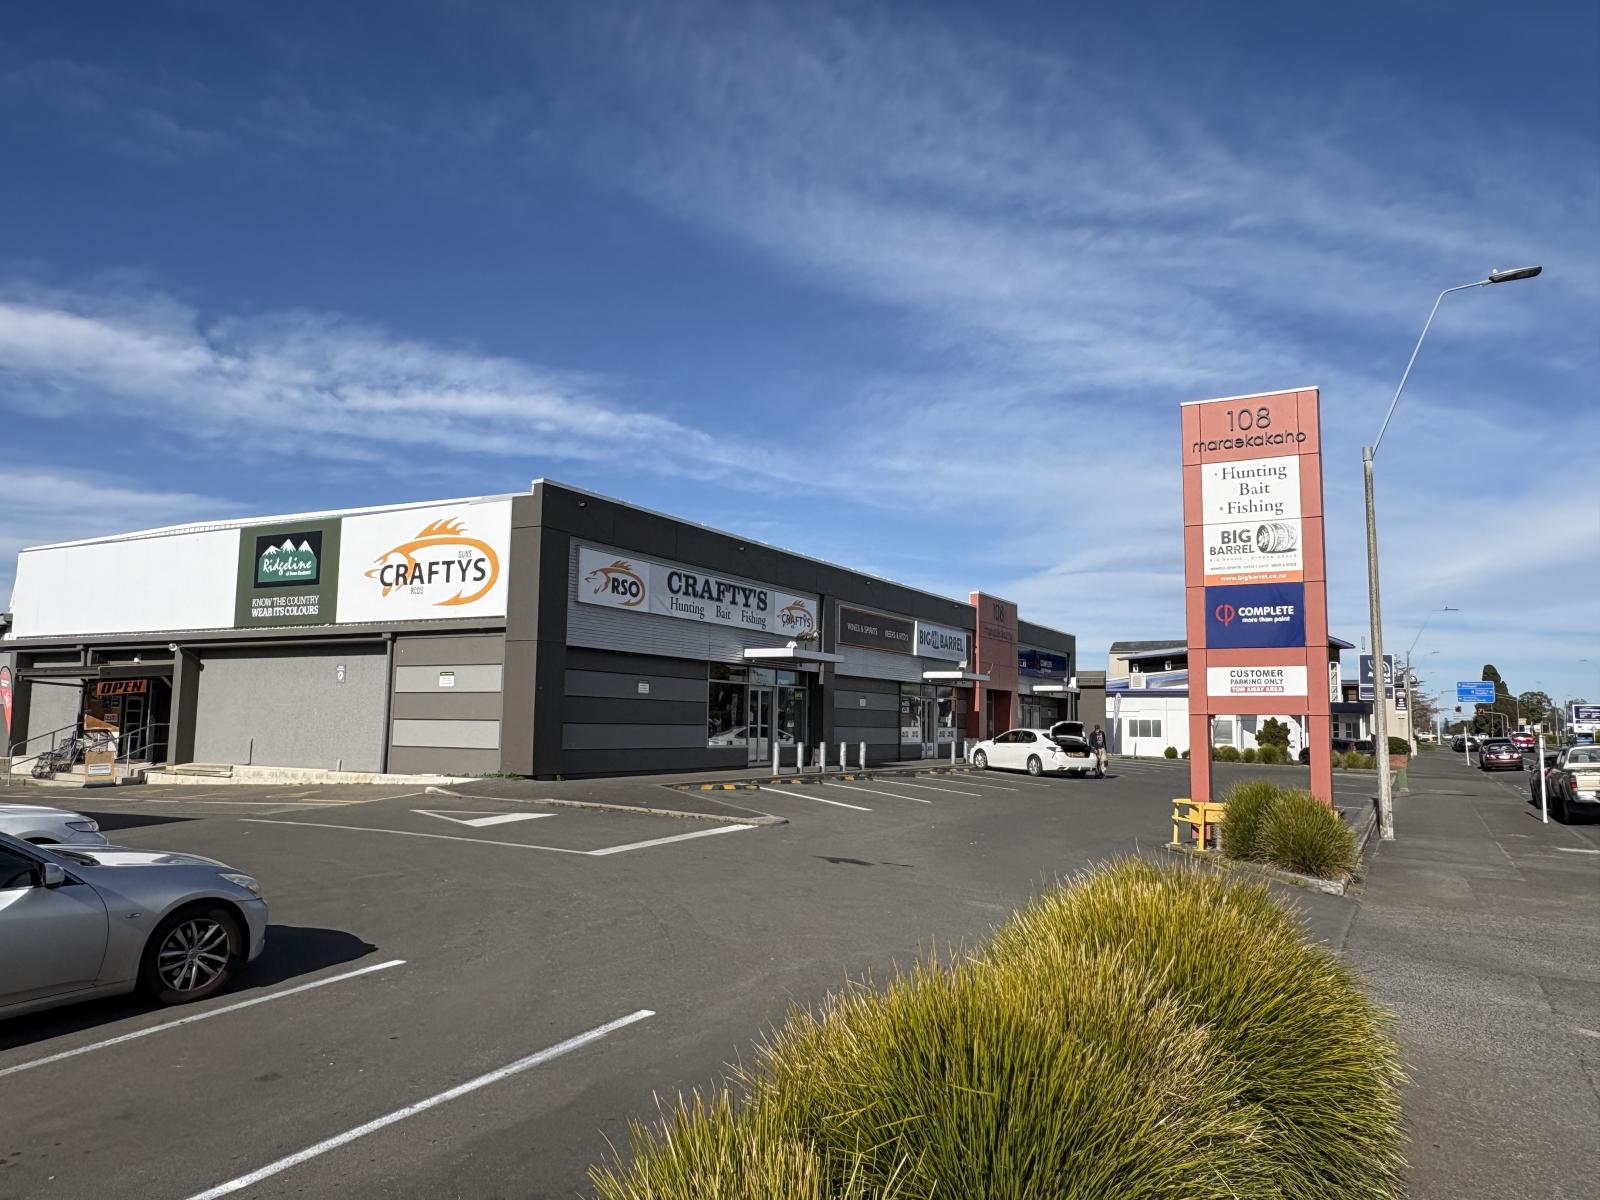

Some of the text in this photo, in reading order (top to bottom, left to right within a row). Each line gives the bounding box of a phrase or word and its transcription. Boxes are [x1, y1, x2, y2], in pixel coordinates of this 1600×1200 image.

[1226, 407, 1272, 432] 108
[1192, 431, 1307, 453] maraekakaho
[1221, 464, 1288, 481] Hunting
[1239, 482, 1271, 496] Bait
[1226, 500, 1284, 516] Fishing
[1220, 529, 1252, 545] BIG
[1209, 544, 1256, 556] BARREL
[262, 556, 312, 576] Ridgeline
[379, 557, 486, 587] CRAFTYS
[611, 576, 641, 598] RSO
[667, 570, 768, 612] CRAFTY'S
[251, 595, 320, 608] KNOW THE COUNTRY
[251, 605, 319, 618] WEAR ITS COLOURS
[670, 596, 767, 630] Hunting Bait Fishing
[1238, 606, 1295, 617] COMPLETE
[1274, 615, 1291, 623] paint
[781, 613, 812, 628] CRAFTYS
[919, 629, 932, 645] BIG
[940, 633, 964, 652] BARREL
[1230, 669, 1284, 678] CUSTOMER
[100, 681, 143, 694] OPEN
